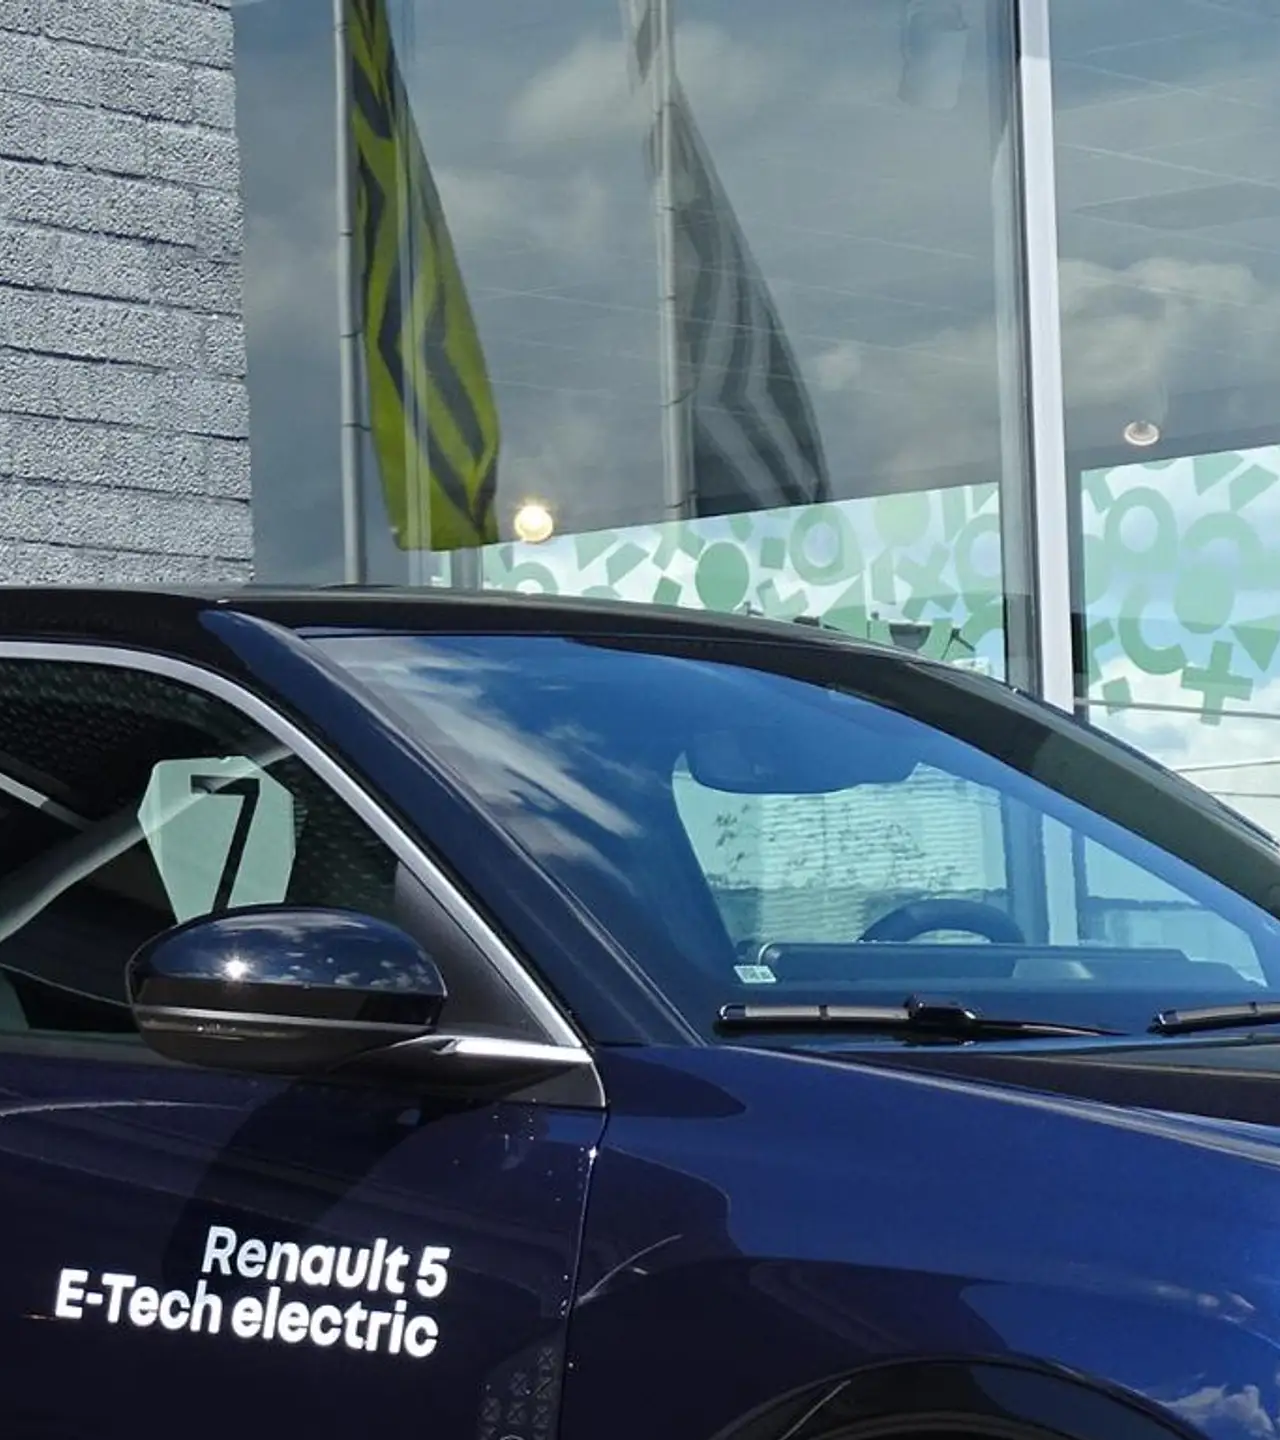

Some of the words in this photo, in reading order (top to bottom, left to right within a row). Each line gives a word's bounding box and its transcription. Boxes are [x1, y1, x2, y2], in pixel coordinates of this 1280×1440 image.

[202, 1225, 410, 1294] Renault
[416, 1246, 451, 1297] 5
[55, 1268, 221, 1334] E-Tech
[232, 1286, 439, 1358] electric
